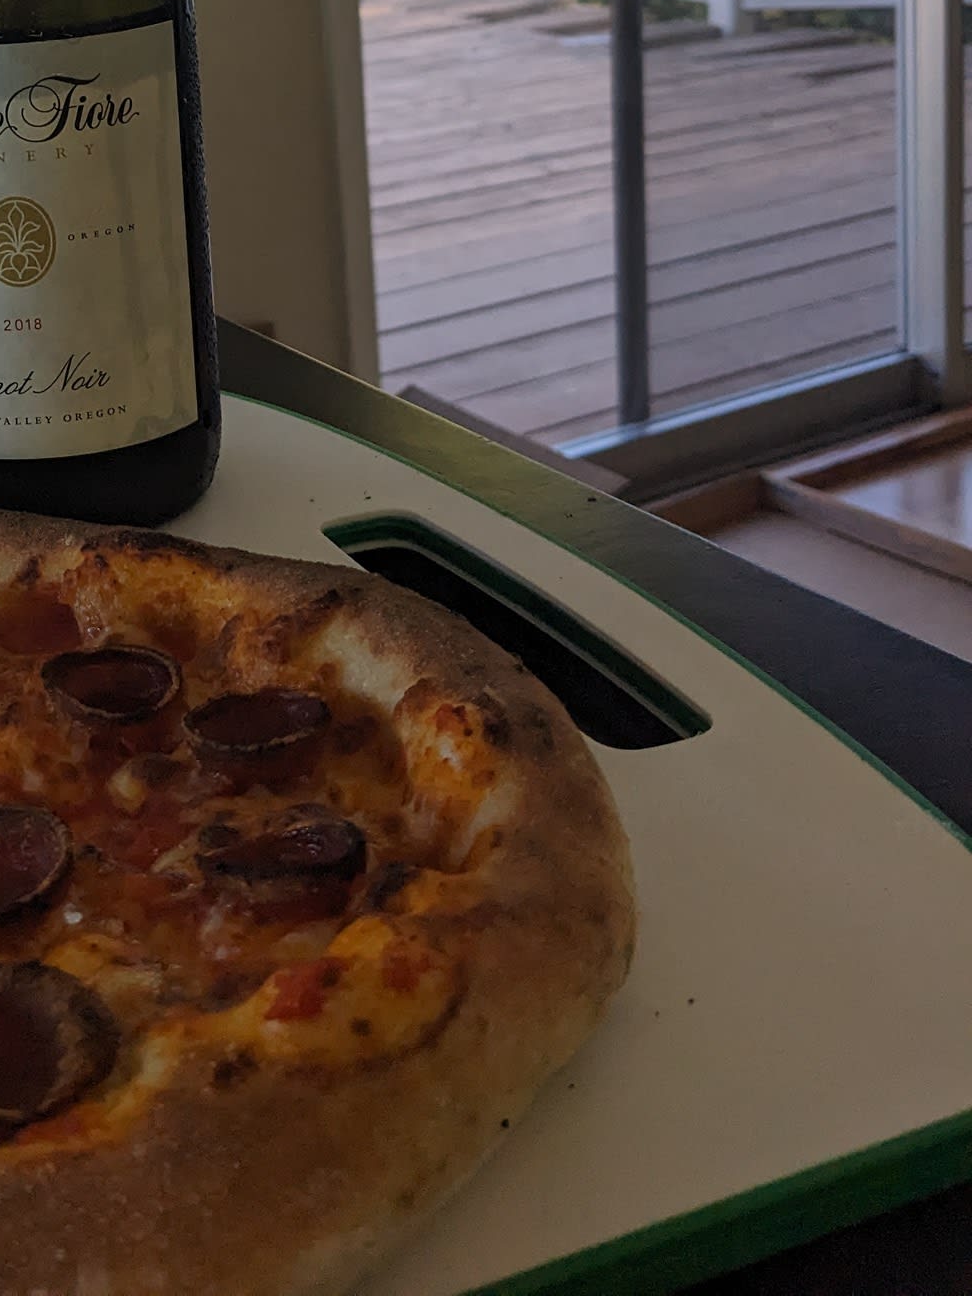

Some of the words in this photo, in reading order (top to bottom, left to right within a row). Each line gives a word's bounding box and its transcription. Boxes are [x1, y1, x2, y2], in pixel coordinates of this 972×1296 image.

[6, 72, 140, 143] Fiore
[67, 223, 136, 241] OREGON
[3, 318, 42, 332] 2018
[31, 351, 110, 393] Noir
[62, 405, 126, 423] OREGON
